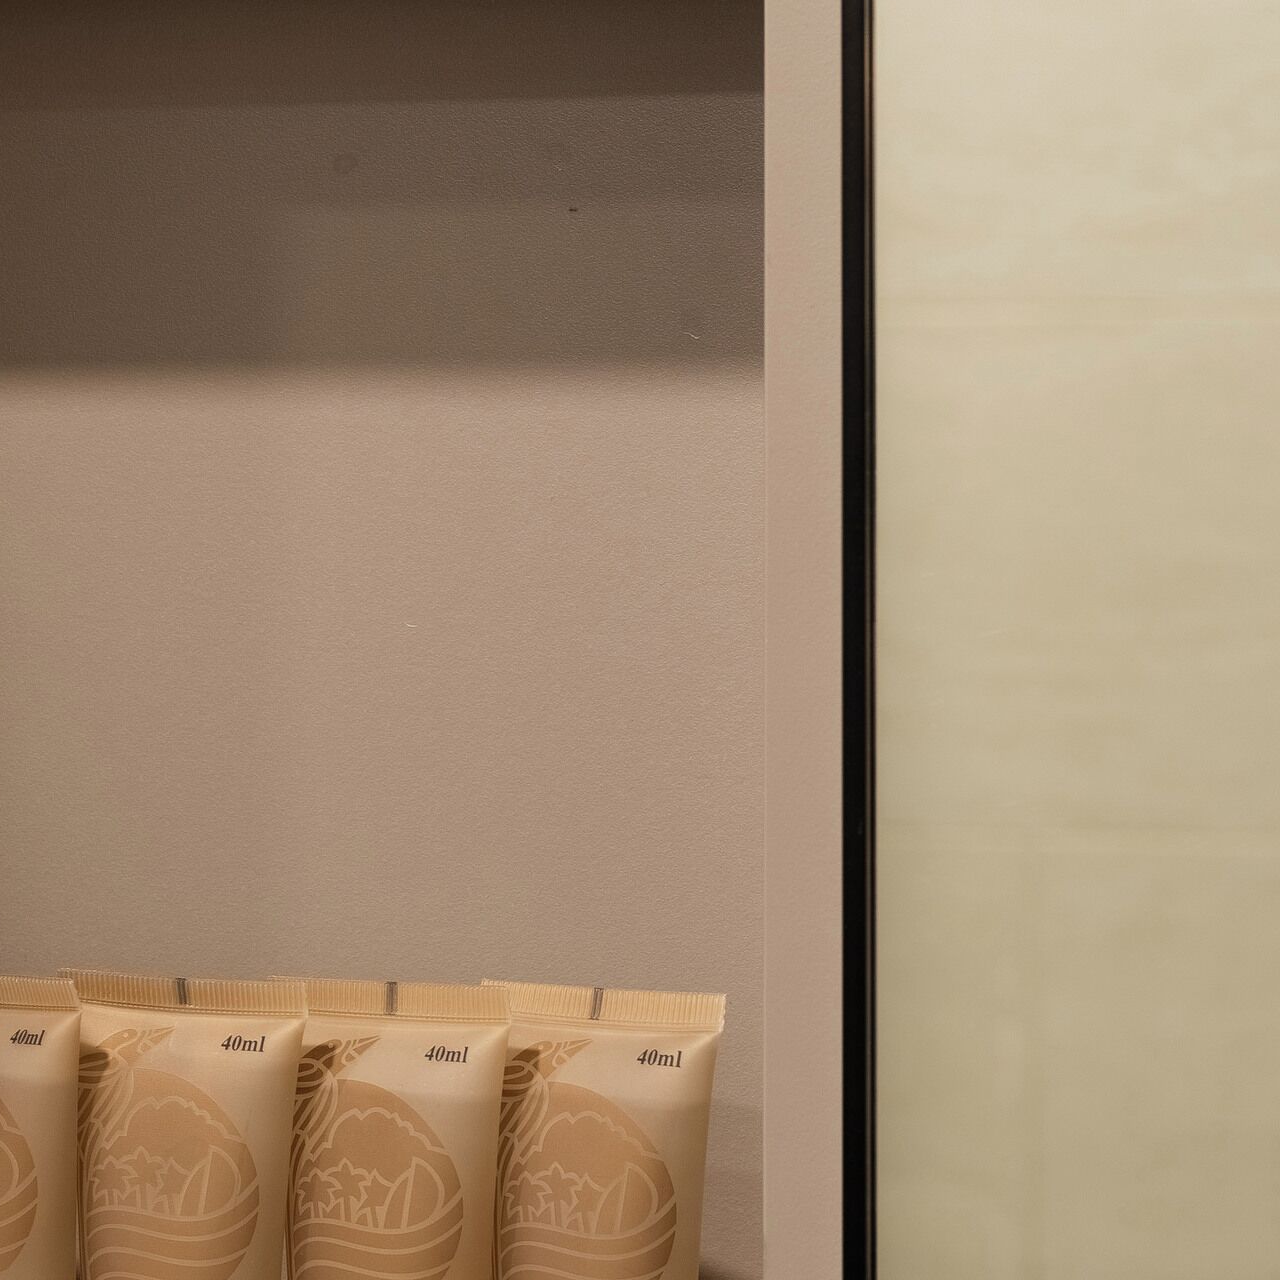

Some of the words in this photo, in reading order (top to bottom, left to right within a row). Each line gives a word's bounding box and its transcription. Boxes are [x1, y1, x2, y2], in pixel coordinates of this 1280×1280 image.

[9, 1028, 46, 1047] 40ml
[220, 1034, 267, 1053] 40ml
[424, 1044, 469, 1064] 40ml
[636, 1048, 683, 1068] 40ml
